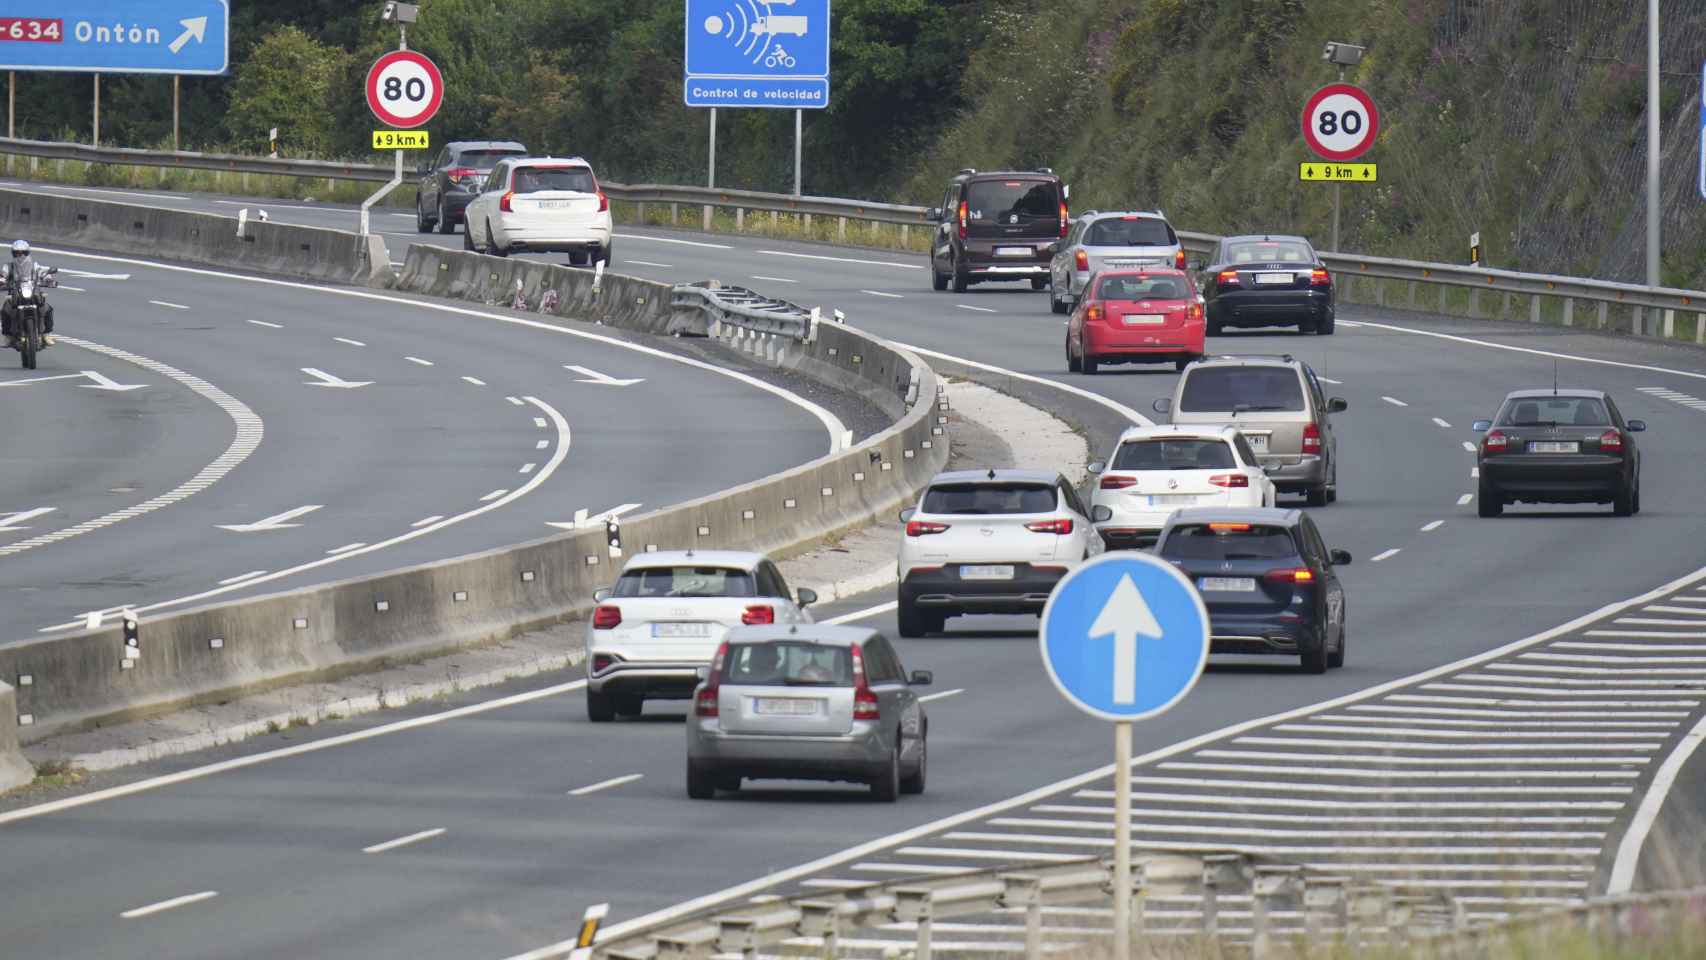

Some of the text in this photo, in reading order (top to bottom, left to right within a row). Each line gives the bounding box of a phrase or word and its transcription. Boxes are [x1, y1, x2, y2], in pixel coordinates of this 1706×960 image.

[75, 21, 160, 44] Ontón
[383, 76, 426, 102] 80
[693, 87, 821, 100] Control de velocidad
[1319, 110, 1362, 136] 80
[386, 134, 416, 146] 9 km
[1325, 166, 1353, 178] 9 km
